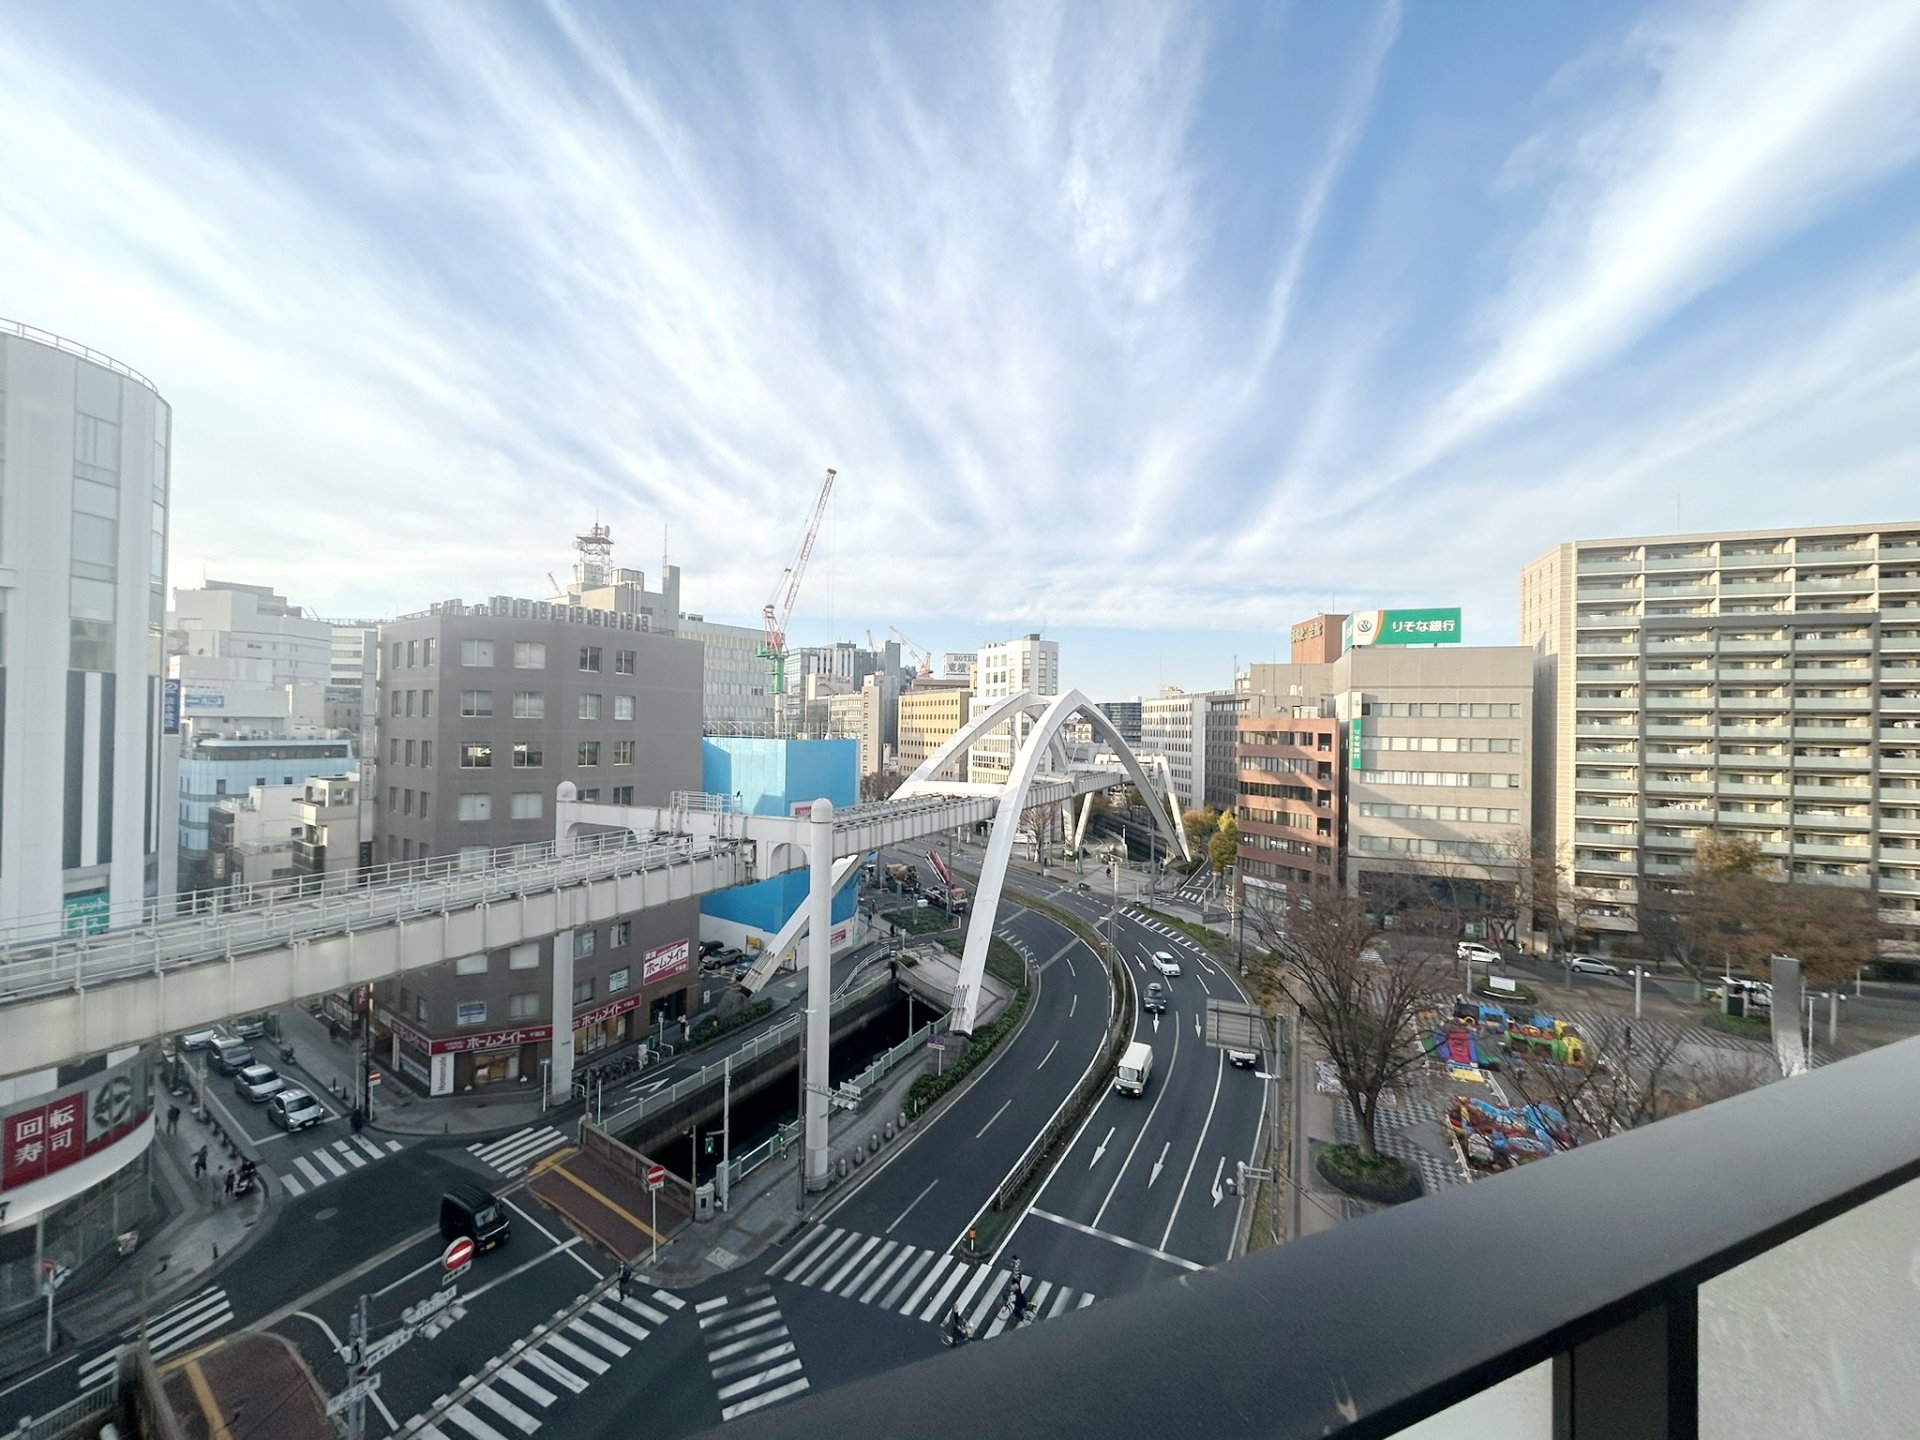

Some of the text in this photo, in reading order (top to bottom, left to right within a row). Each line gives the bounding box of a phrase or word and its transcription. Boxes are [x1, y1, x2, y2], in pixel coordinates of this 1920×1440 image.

[1392, 619, 1456, 633] りそな銀行
[645, 946, 686, 975] ホームメイト
[582, 1004, 622, 1026] ホームメイト
[467, 1031, 526, 1048] ホームメイト
[15, 1104, 75, 1142] 回転
[14, 1127, 73, 1168] 寿司
